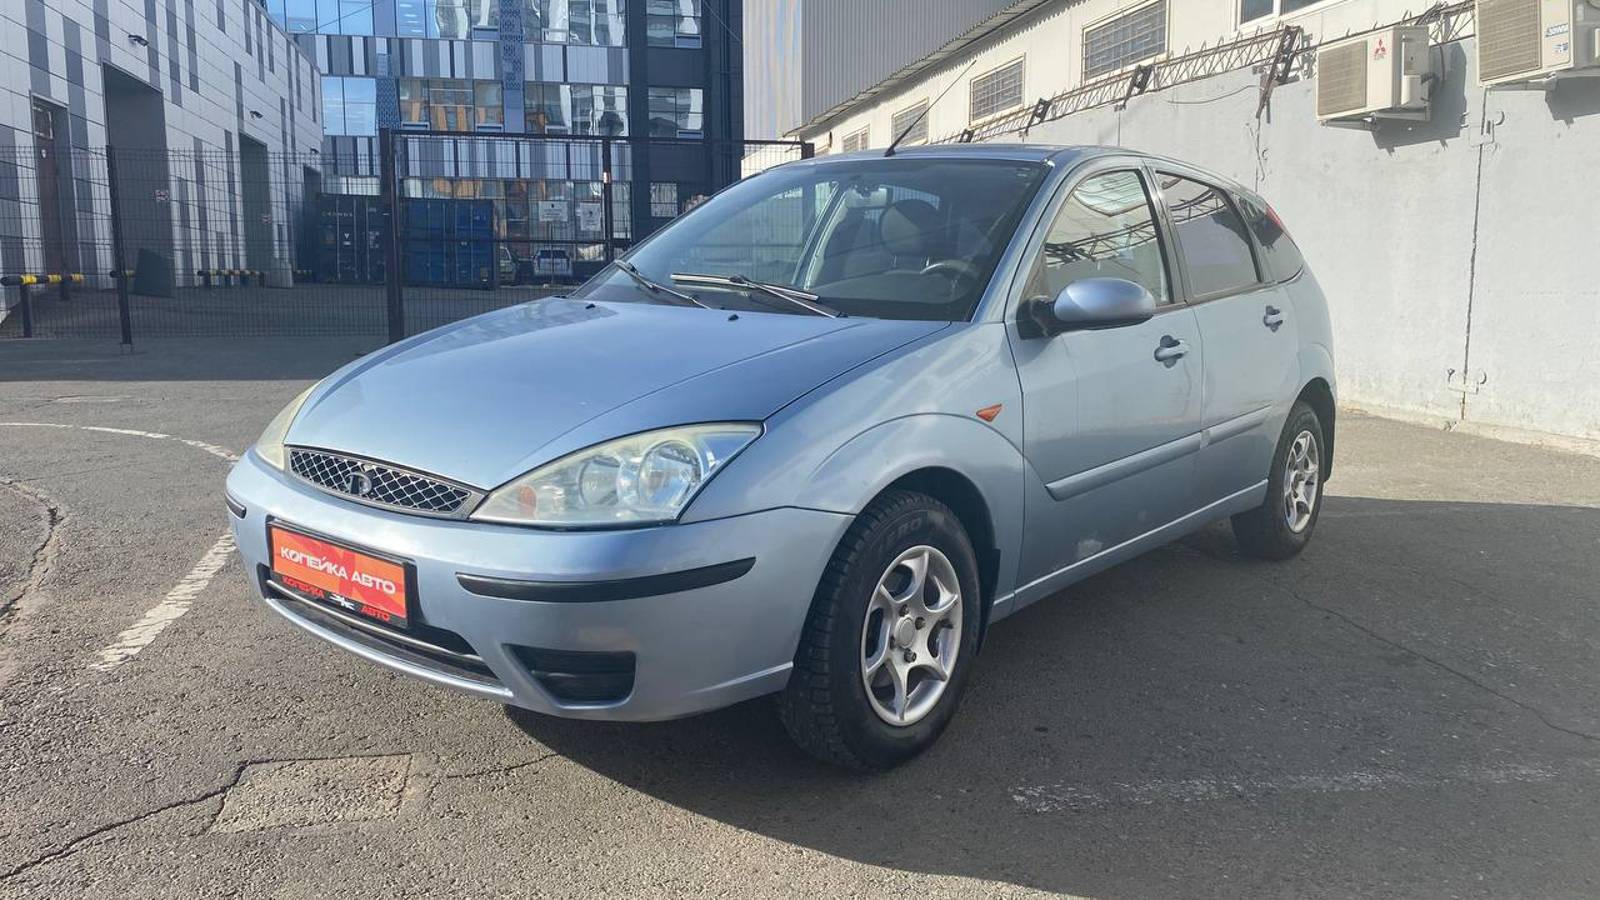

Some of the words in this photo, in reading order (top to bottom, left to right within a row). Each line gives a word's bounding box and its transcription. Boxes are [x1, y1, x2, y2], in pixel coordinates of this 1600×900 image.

[280, 546, 348, 580] КОПЕЙКА
[351, 571, 396, 595] АВТО
[361, 605, 390, 621] АВТО
